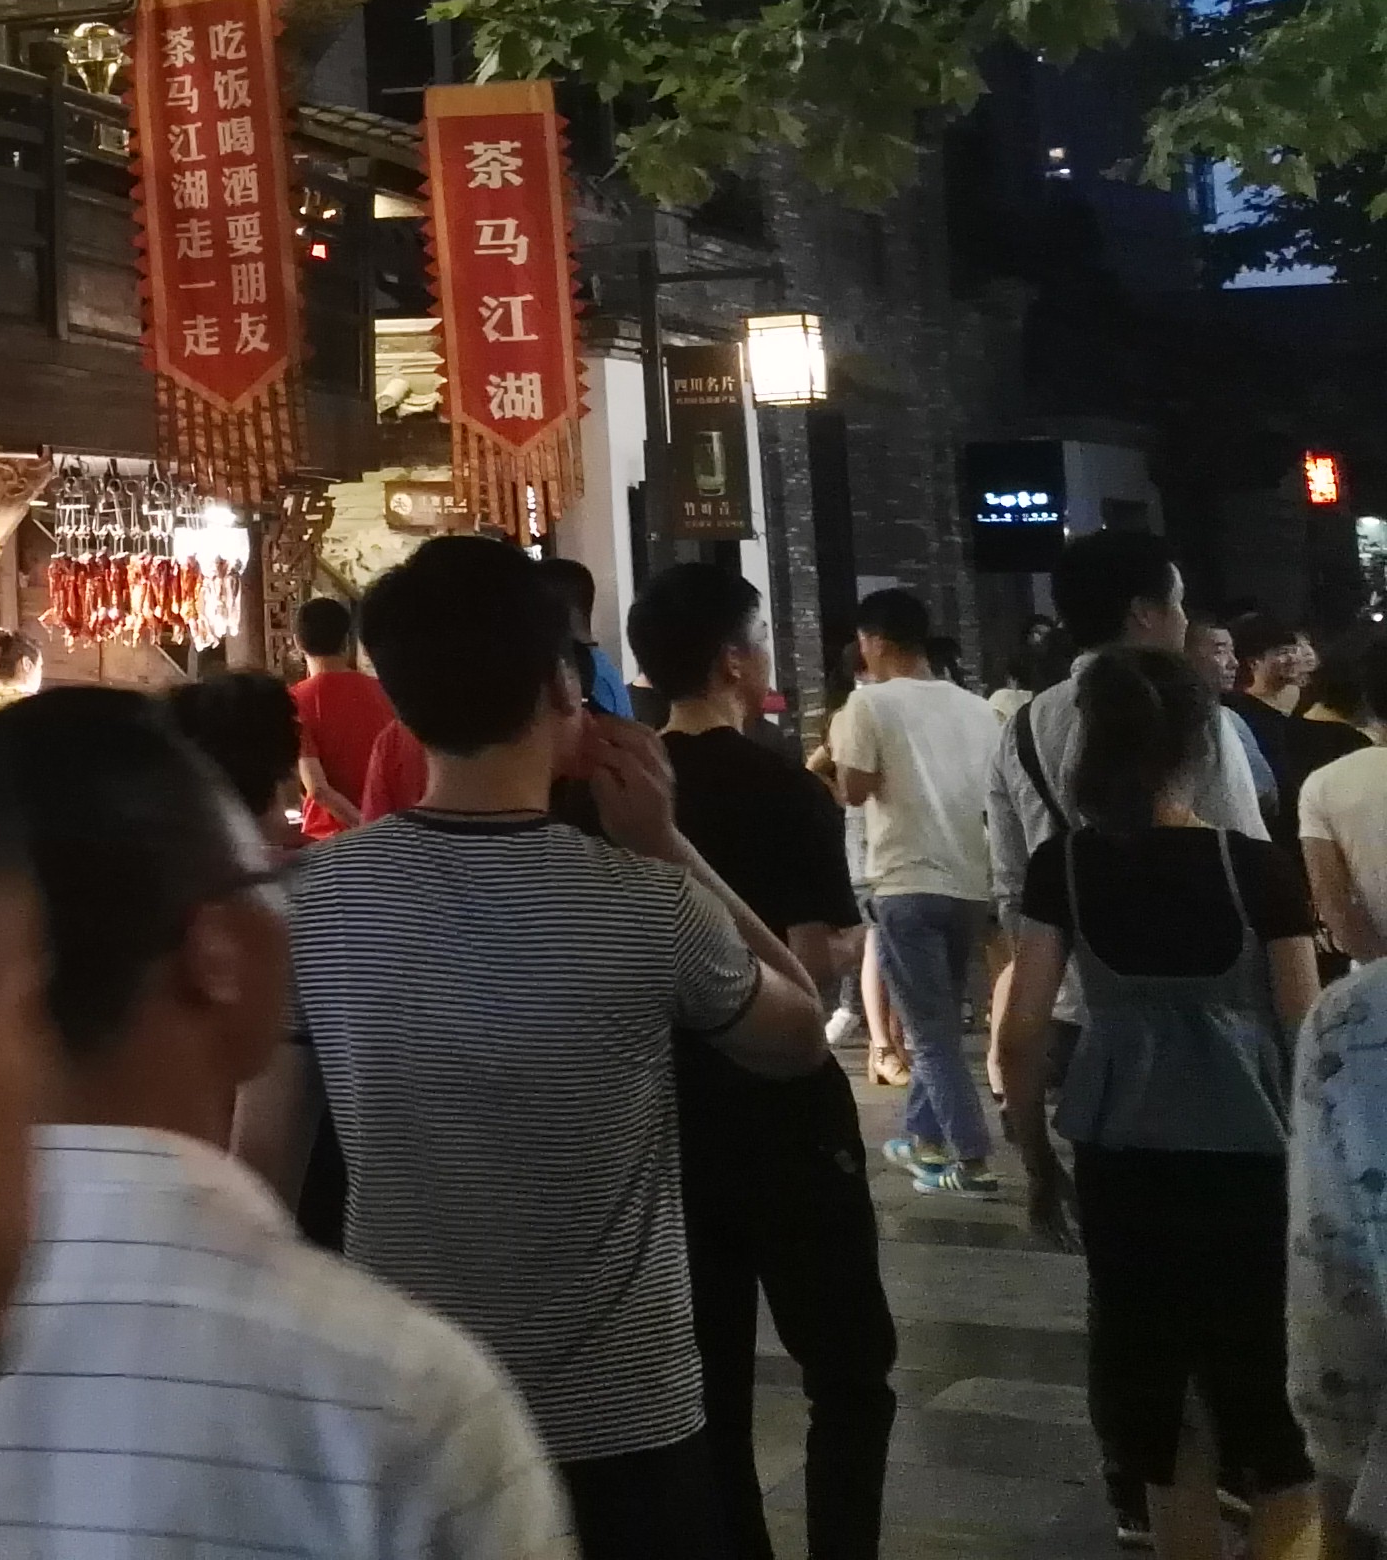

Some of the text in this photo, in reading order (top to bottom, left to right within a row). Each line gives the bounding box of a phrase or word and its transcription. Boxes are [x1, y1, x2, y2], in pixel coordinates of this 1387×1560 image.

[161, 26, 221, 358] 茶马江湖走一走
[208, 20, 271, 355] 吃饭喝酒耍朋友
[464, 141, 545, 422] 茶马江湖
